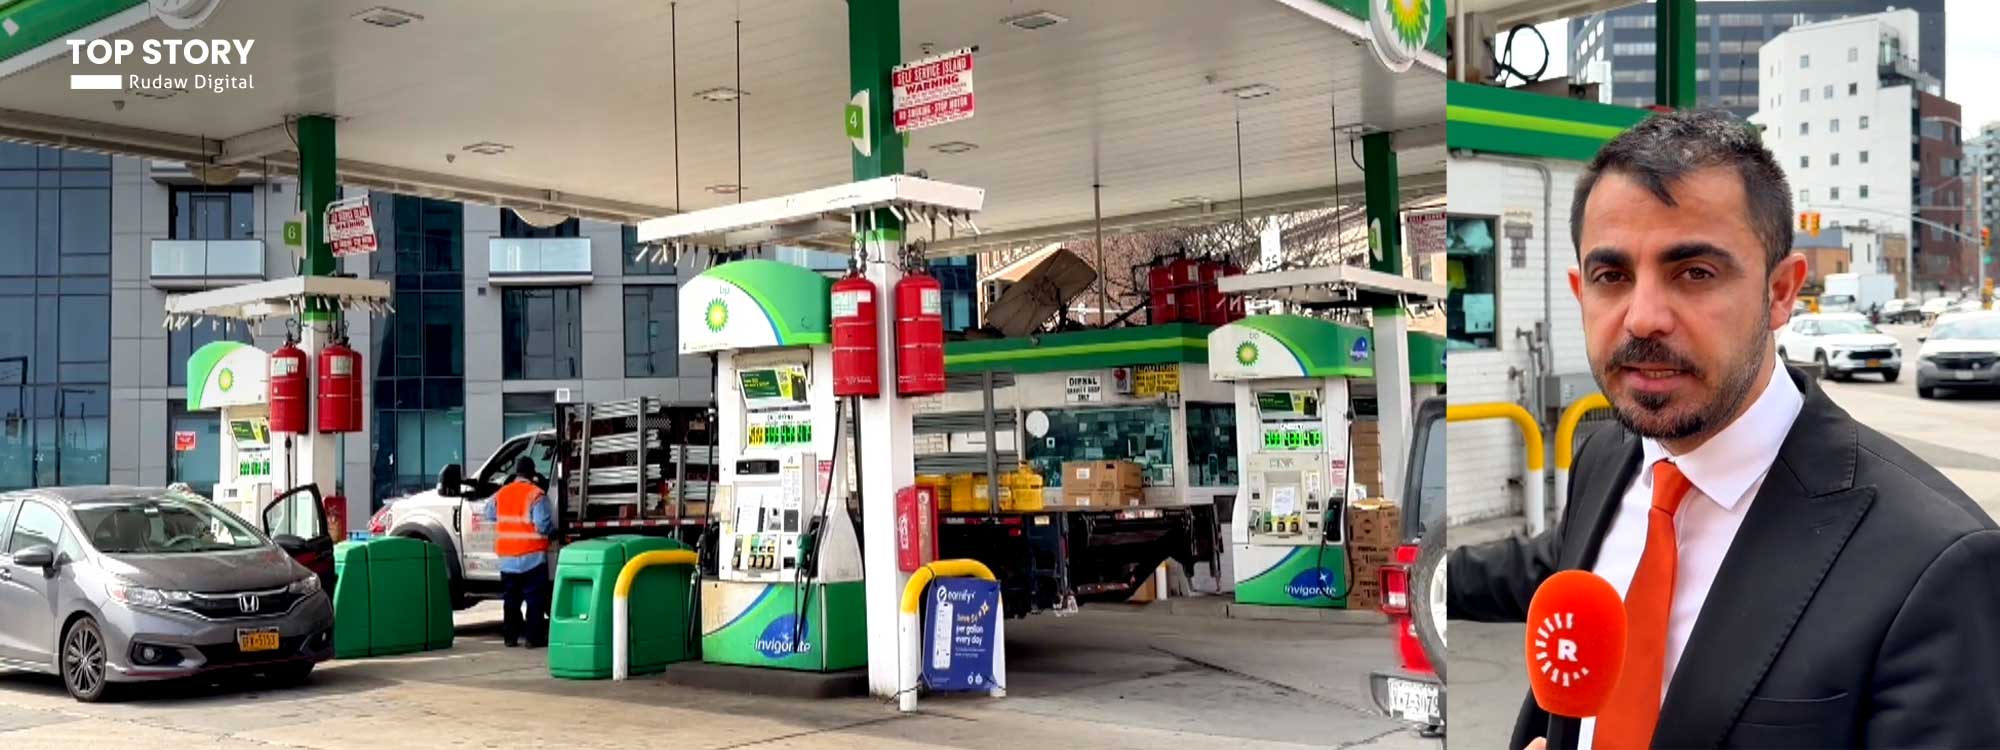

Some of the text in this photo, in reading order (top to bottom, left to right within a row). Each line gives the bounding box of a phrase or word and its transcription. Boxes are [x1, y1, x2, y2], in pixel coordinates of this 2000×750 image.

[914, 62, 941, 82] SERVICE
[943, 56, 967, 76] ISLAND
[905, 74, 959, 95] WARNING
[849, 110, 858, 129] 4
[287, 225, 297, 240] 6
[966, 624, 984, 636] gallon
[754, 637, 811, 655] Invigorte
[955, 635, 983, 647] every day
[1557, 638, 1579, 662] R
